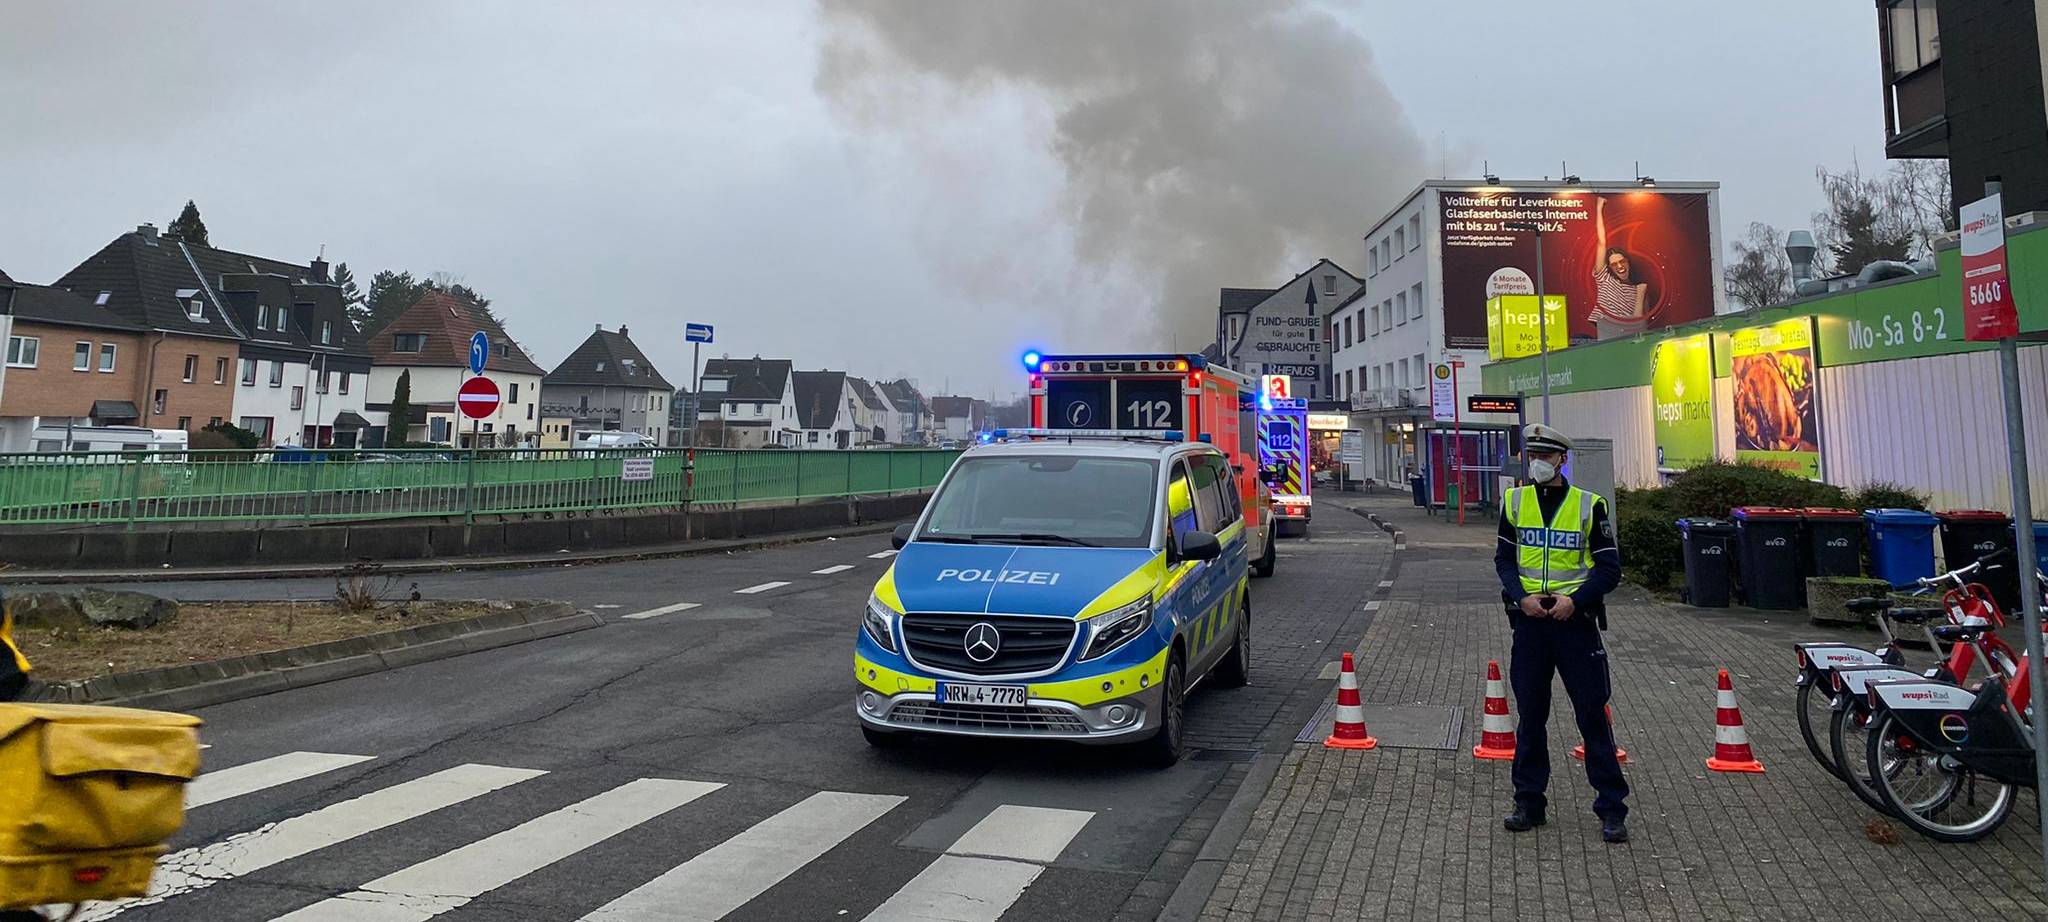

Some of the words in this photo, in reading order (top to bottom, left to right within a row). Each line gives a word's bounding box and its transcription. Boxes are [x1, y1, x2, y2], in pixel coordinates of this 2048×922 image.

[1445, 196, 1500, 207] Volltreffer
[1501, 196, 1516, 207] für
[1519, 197, 1583, 207] Leverkusen:
[1446, 209, 1543, 219] Glasfaserbasiertes
[1545, 210, 1588, 220] Internet
[1446, 221, 1464, 231] mit
[1466, 221, 1482, 231] bis
[1484, 223, 1497, 231] zu
[1493, 283, 1527, 291] Tarifpreis
[1970, 281, 2001, 306] 5660
[1256, 316, 1320, 327] FUND-GRUBE
[1286, 330, 1305, 338] gute
[1255, 342, 1321, 352] GEBRAUCHTE
[1270, 364, 1315, 376] RHENUS
[1127, 400, 1172, 428] 112
[1271, 434, 1291, 446] 112
[1520, 529, 1581, 548] POLIZEI
[936, 569, 1060, 585] POLIZEI
[944, 686, 969, 701] NRW
[976, 687, 1024, 704] 4-7778
